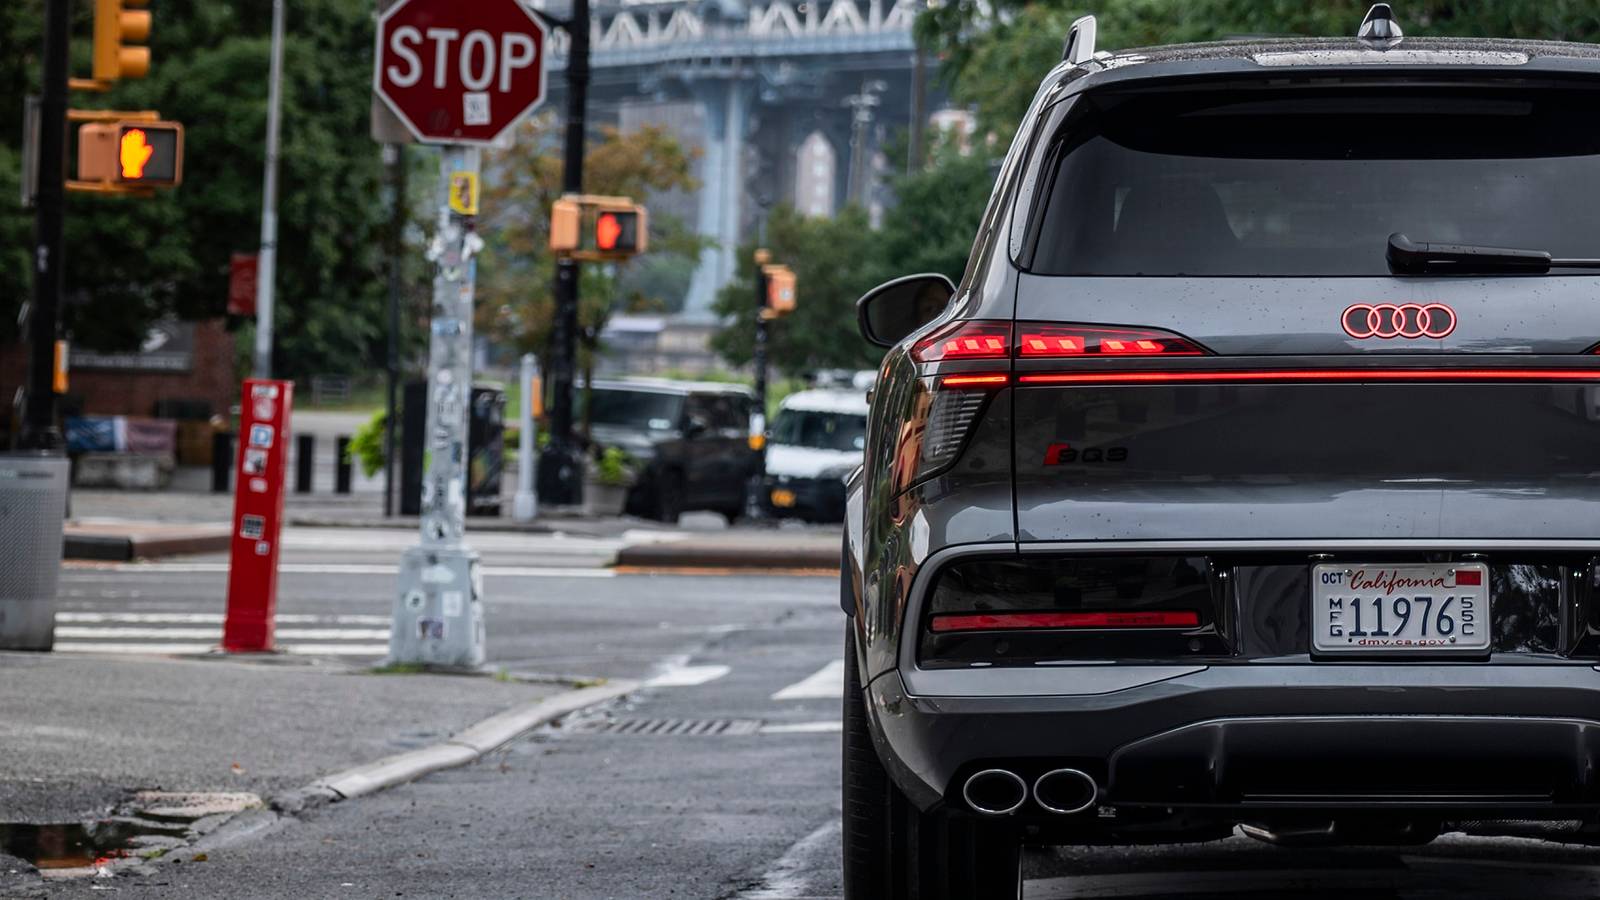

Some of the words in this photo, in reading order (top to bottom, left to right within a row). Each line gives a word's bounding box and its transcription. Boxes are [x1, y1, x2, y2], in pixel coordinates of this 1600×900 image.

[387, 25, 537, 93] STOP
[1321, 572, 1343, 584] OCT
[1350, 570, 1456, 595] California
[1329, 598, 1343, 637] MFG
[1349, 596, 1455, 637] 11976
[1358, 638, 1446, 646] dmv.ca.gov
